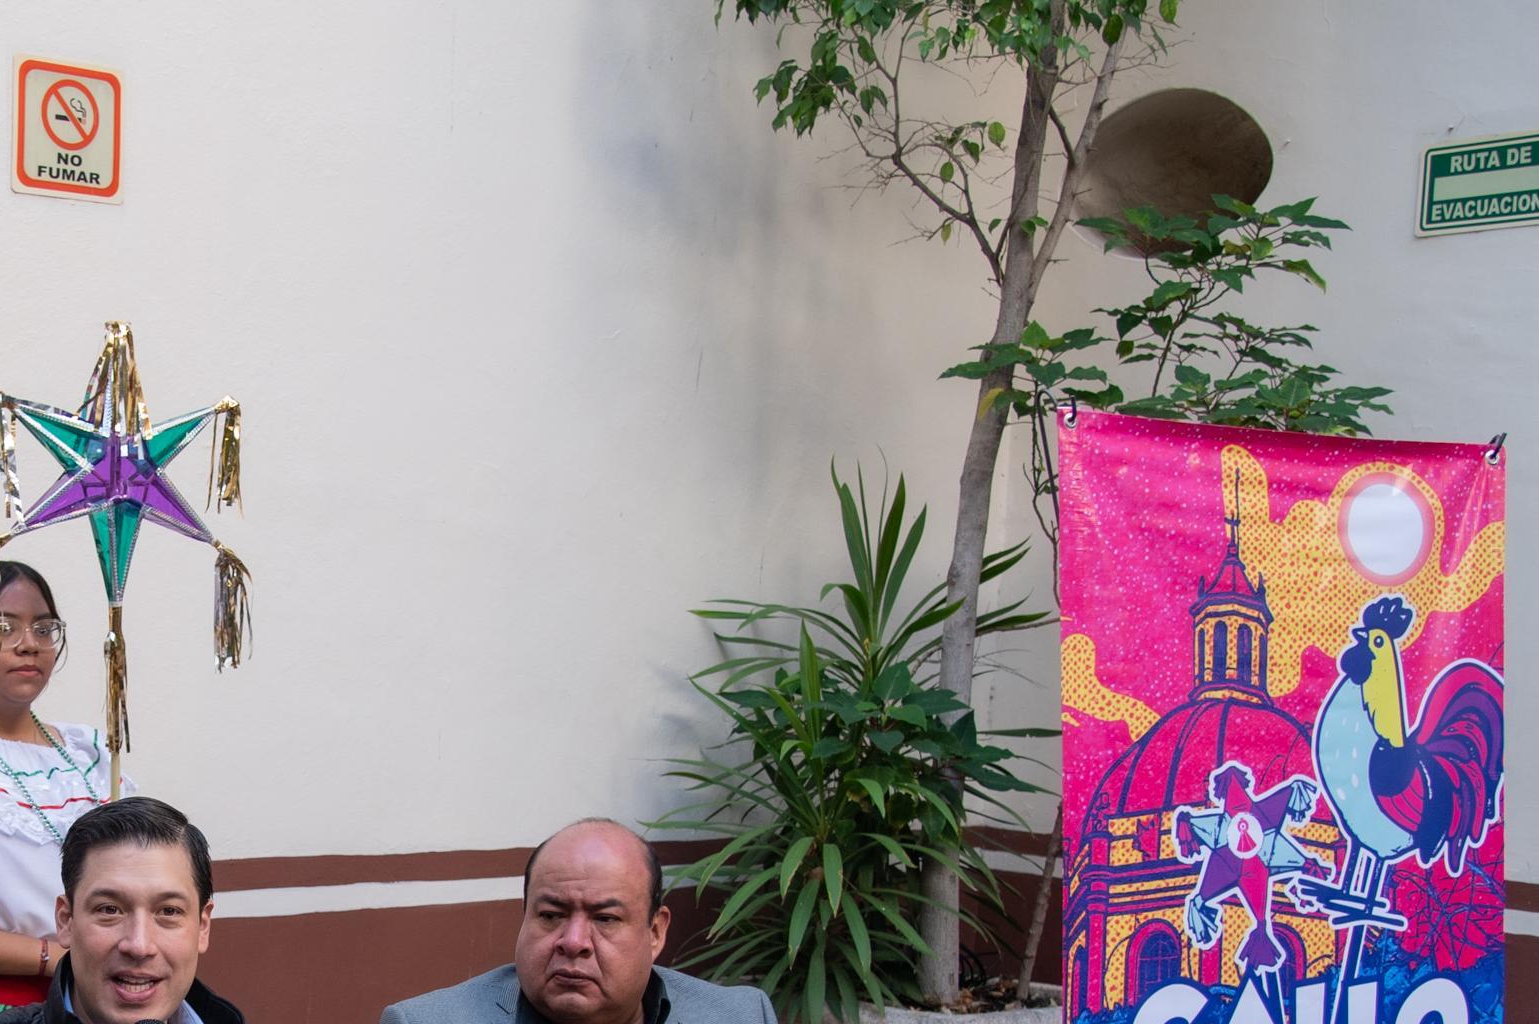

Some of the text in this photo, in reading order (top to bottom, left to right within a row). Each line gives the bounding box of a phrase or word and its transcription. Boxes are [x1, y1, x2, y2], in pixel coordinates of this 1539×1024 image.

[56, 152, 82, 167] NO
[1449, 146, 1532, 173] RUTA DE
[37, 166, 101, 185] FUMAR
[1431, 193, 1539, 222] EVACUACION
